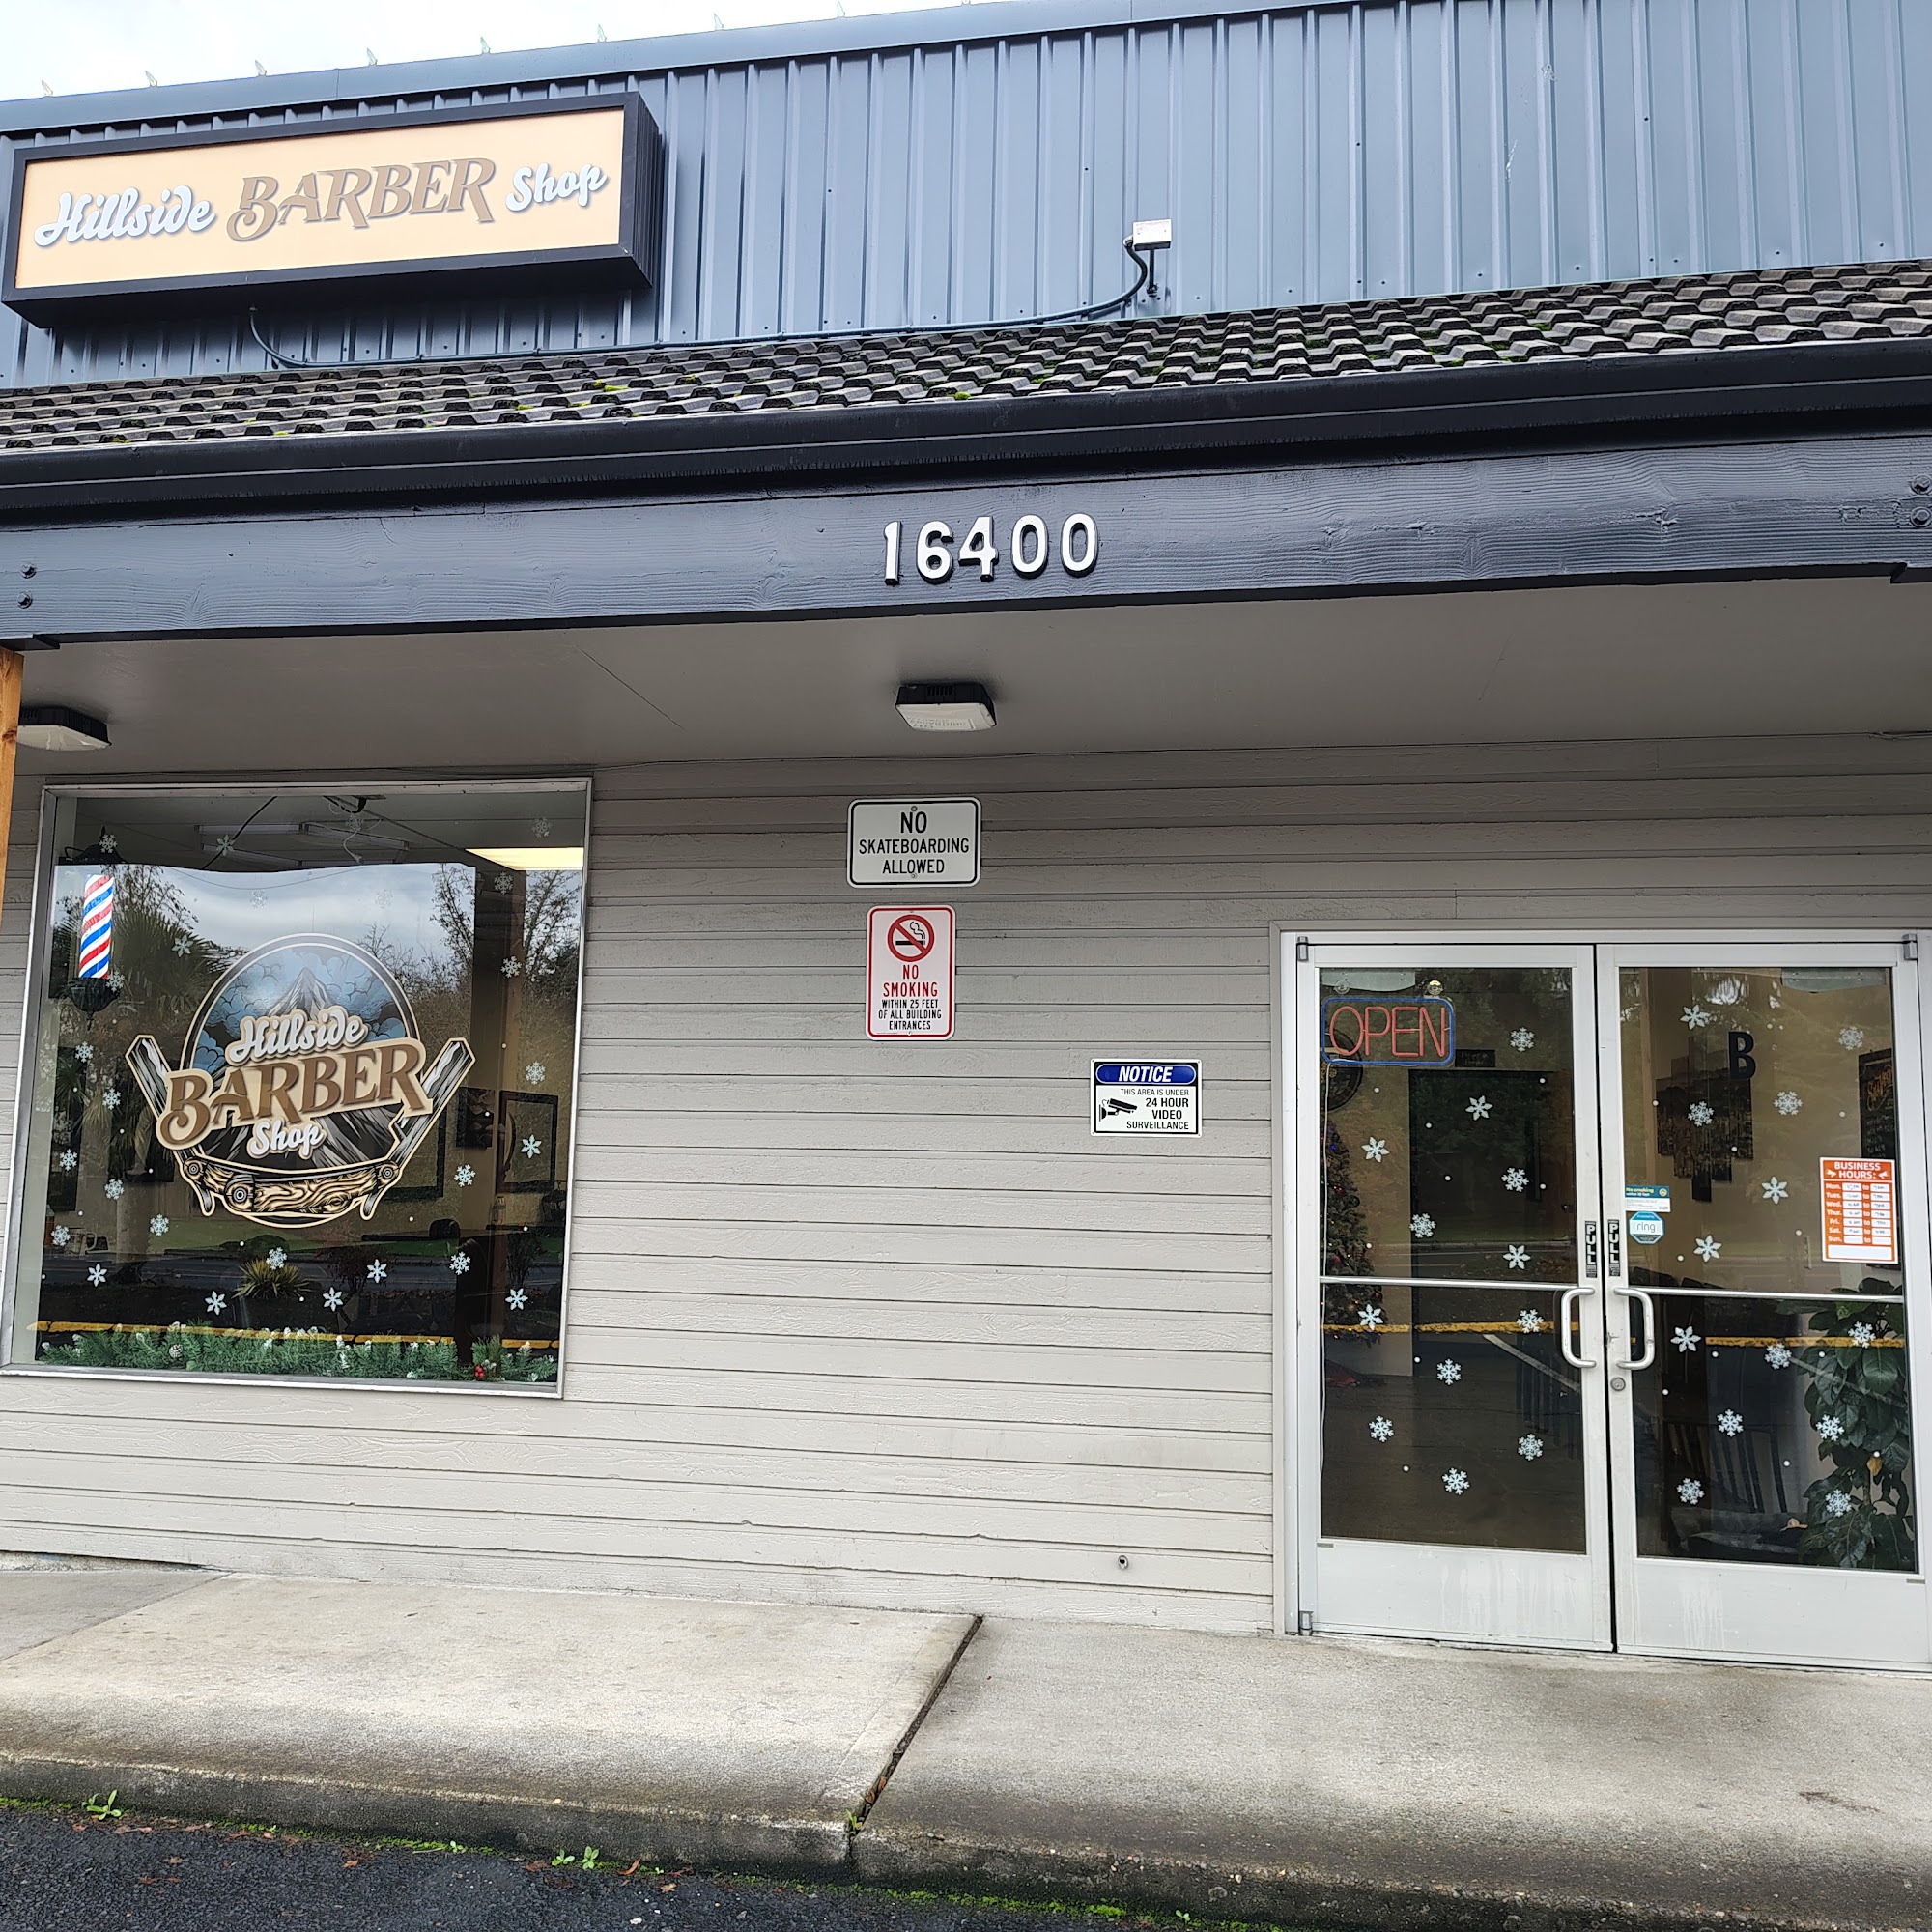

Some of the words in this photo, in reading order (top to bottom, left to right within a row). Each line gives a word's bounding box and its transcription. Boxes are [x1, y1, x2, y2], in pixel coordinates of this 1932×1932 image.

[34, 185, 216, 247] Hillside
[226, 157, 496, 242] BARBER
[504, 162, 608, 213] Shop
[884, 513, 1098, 584] 16400
[900, 811, 928, 834] NO
[859, 838, 970, 854] SKATEBOARDING
[882, 859, 945, 874] ALLOWED
[902, 964, 919, 980] NO
[883, 981, 938, 998] SMOKING
[881, 999, 907, 1009] WITHIN
[910, 999, 920, 1009] 25
[922, 999, 939, 1009] FEET
[878, 1009, 888, 1019] OF
[890, 1009, 903, 1019] ALL
[906, 1009, 942, 1019] BUILDING
[889, 1020, 931, 1031] ENTRANCES
[1329, 1006, 1446, 1058] OPEN
[229, 1009, 363, 1059] Hillside
[1728, 1031, 1756, 1080] B
[1119, 1065, 1173, 1082] NOTICE
[159, 1043, 425, 1145] BARBER
[1165, 1088, 1189, 1096] UNDER
[1146, 1097, 1157, 1108] 24
[1160, 1097, 1189, 1108] HOUR
[1151, 1109, 1182, 1120] VIDEO
[1126, 1121, 1189, 1130] SURVEILLANCE
[249, 1120, 325, 1156] Shop
[1834, 1162, 1881, 1171] BUSINESS
[1838, 1170, 1876, 1179] HOURS:
[1636, 1222, 1656, 1233] ring
[1586, 1224, 1596, 1265] PULL
[1608, 1223, 1619, 1264] PULL
